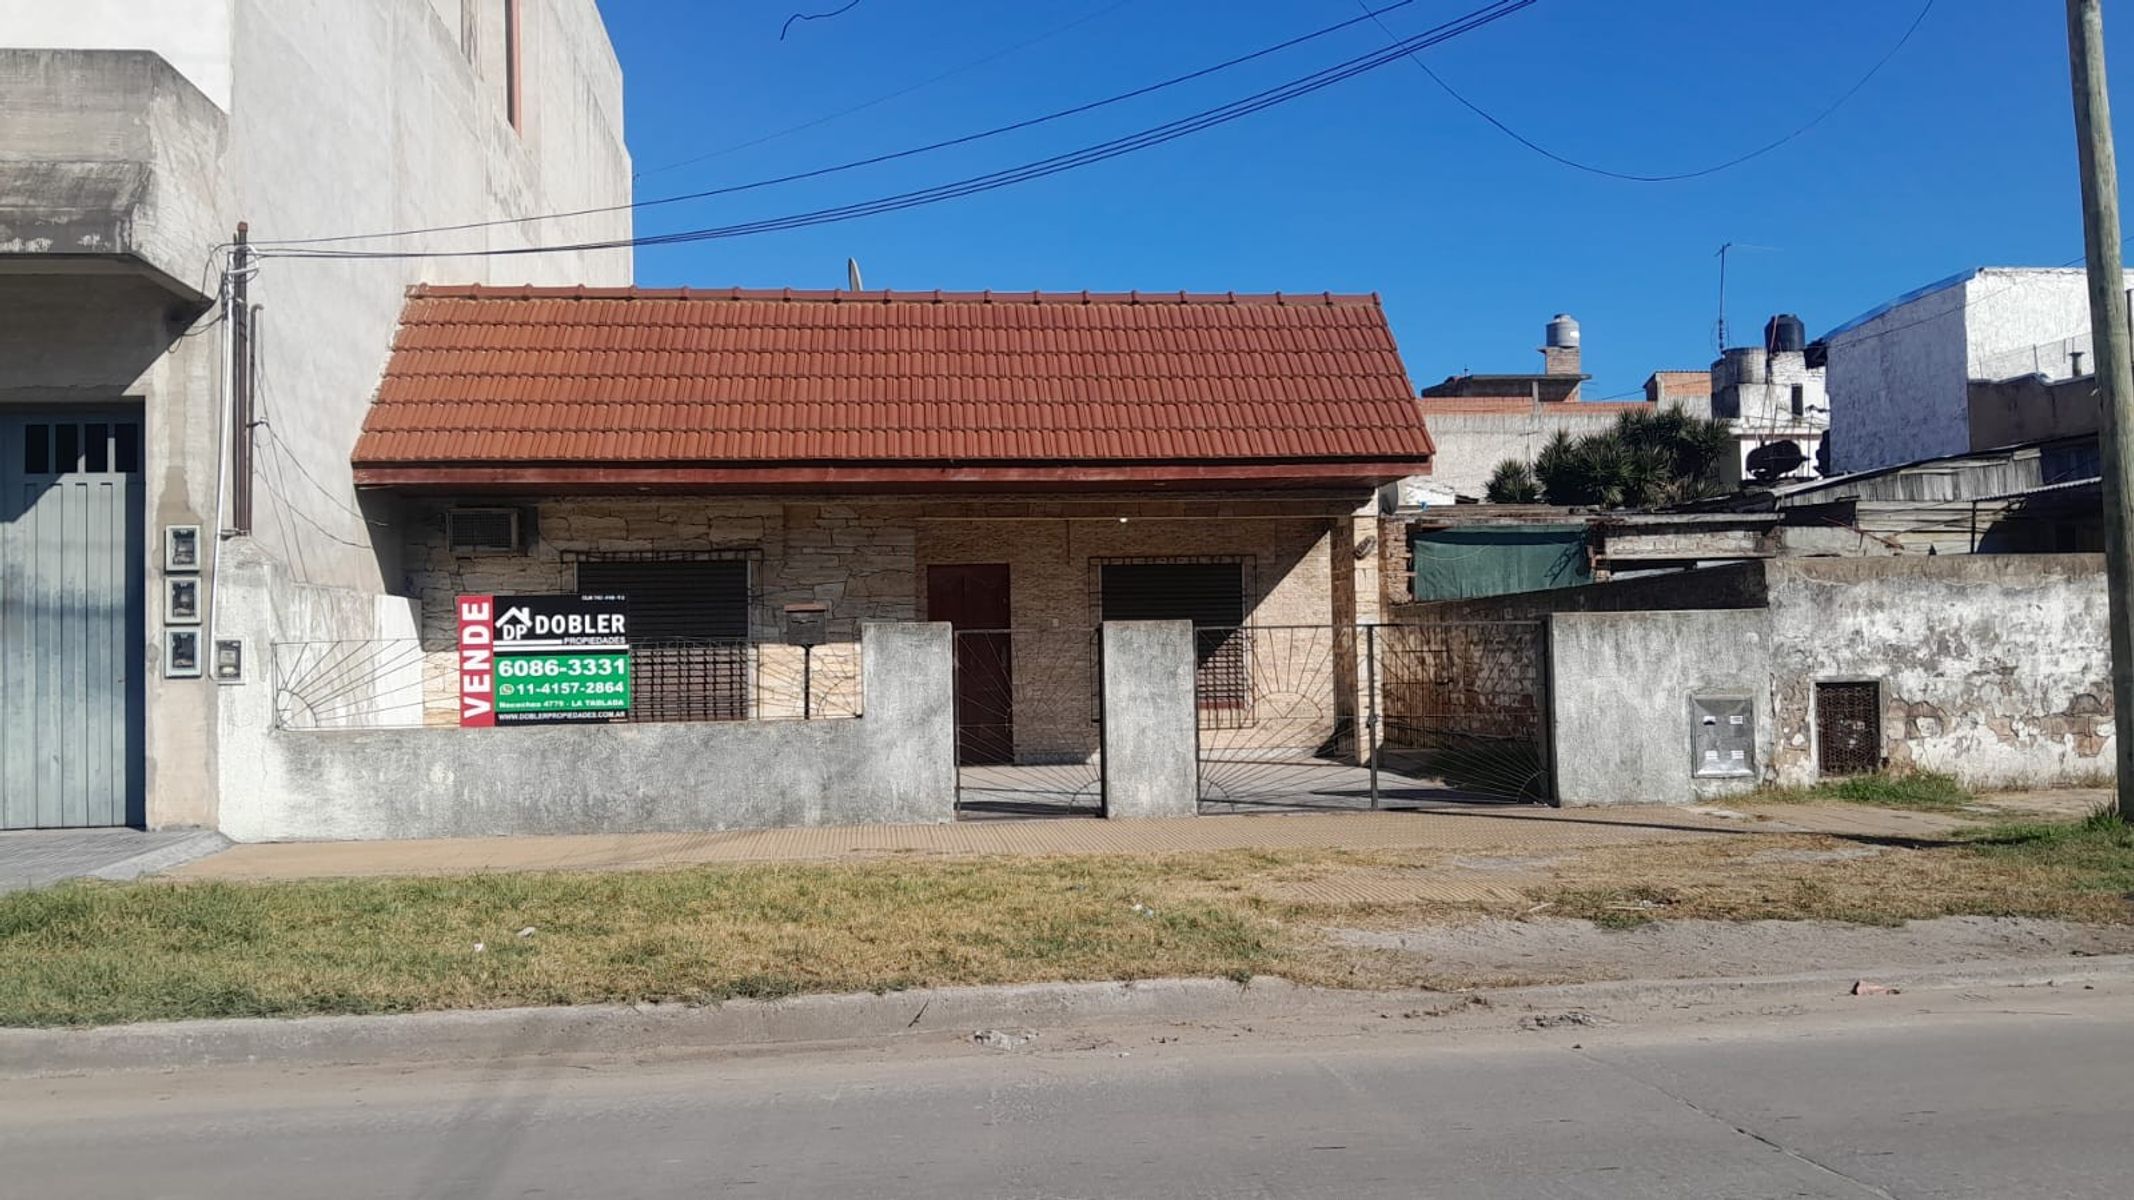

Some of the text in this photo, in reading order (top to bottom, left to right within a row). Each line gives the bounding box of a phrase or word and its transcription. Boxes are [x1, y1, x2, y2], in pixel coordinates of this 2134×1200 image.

[502, 624, 527, 640] DP
[535, 614, 626, 634] DOBLER
[563, 637, 626, 645] PROPIEDADES
[461, 602, 490, 719] VENDE
[498, 658, 625, 677] 6086-3331
[516, 682, 624, 694] 11-4157-2864
